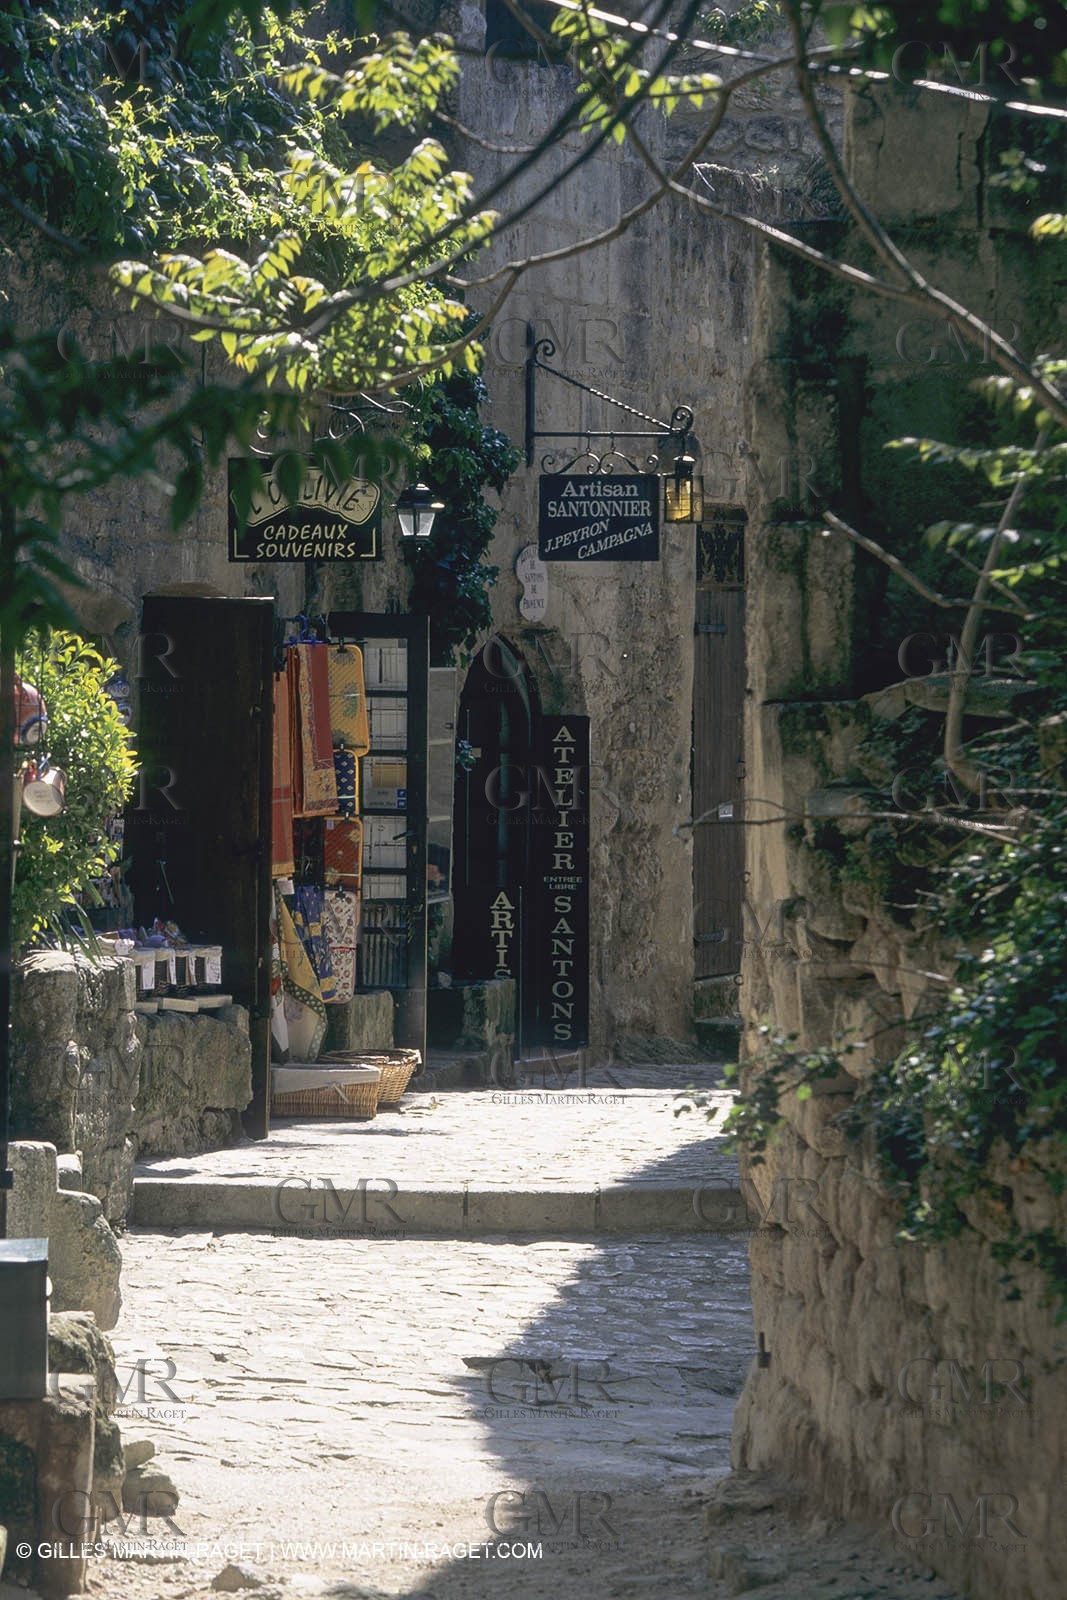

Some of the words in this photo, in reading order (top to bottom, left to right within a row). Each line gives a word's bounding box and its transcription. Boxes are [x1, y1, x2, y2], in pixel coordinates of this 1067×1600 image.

[561, 481, 639, 497] Artisan
[547, 500, 652, 518] SANTONNIER
[263, 524, 349, 541] CADEAUX
[545, 519, 610, 553] J.PEYRON
[577, 522, 654, 559] CAMPAGNA
[256, 542, 356, 558] SOUVENIRS
[552, 725, 577, 870] ATELIER
[552, 895, 576, 1041] SANTONS
